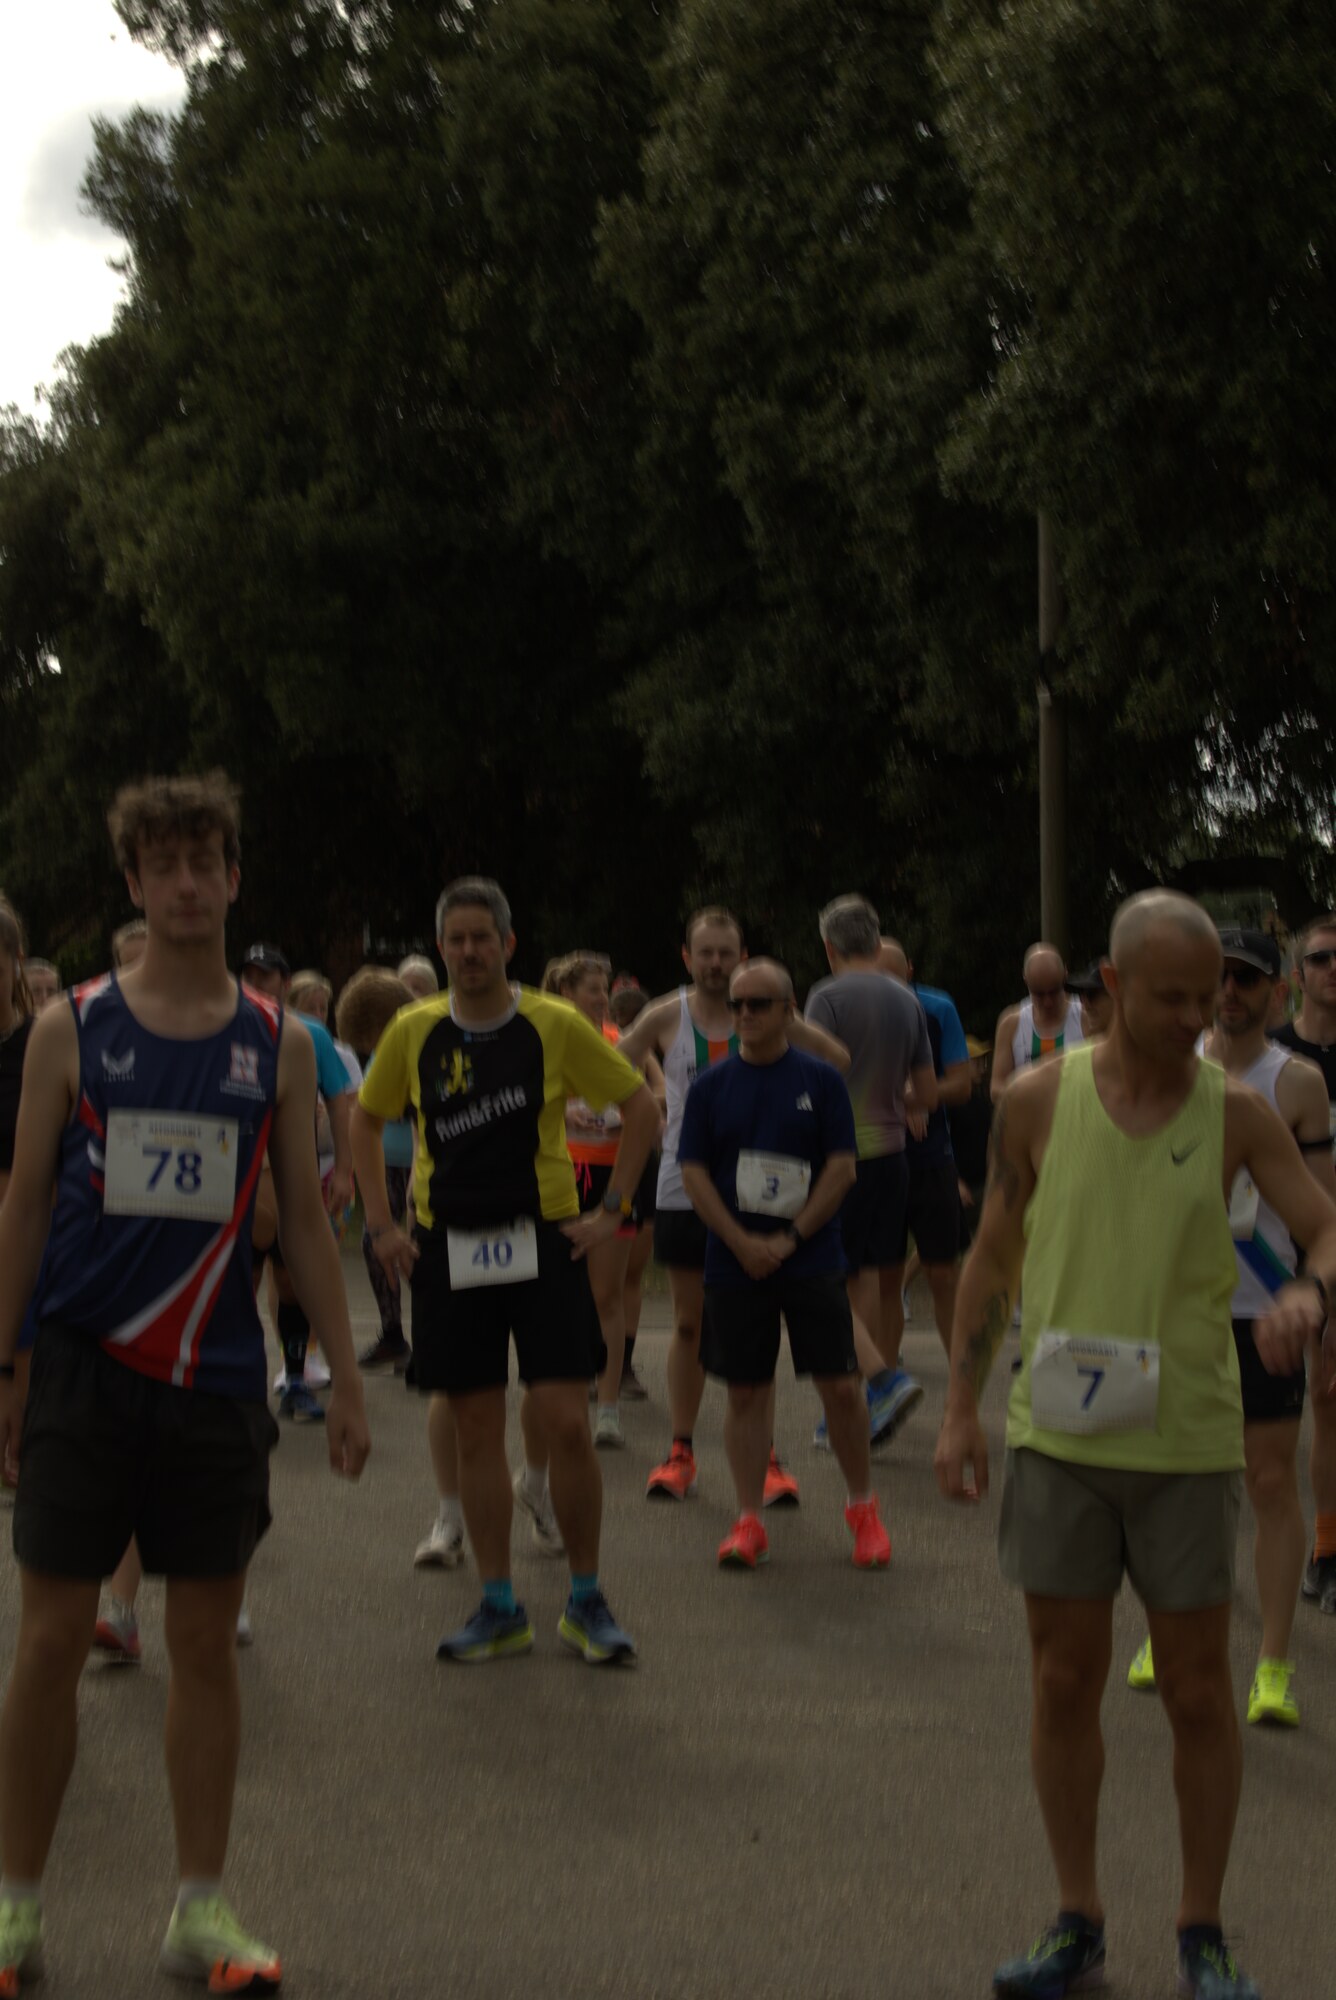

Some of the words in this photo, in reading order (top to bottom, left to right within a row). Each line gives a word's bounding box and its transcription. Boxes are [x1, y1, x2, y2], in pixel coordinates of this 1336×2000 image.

[142, 1145, 202, 1194] 78
[762, 1176, 780, 1201] 3
[472, 1236, 512, 1269] 40
[1078, 1364, 1105, 1410] 7
